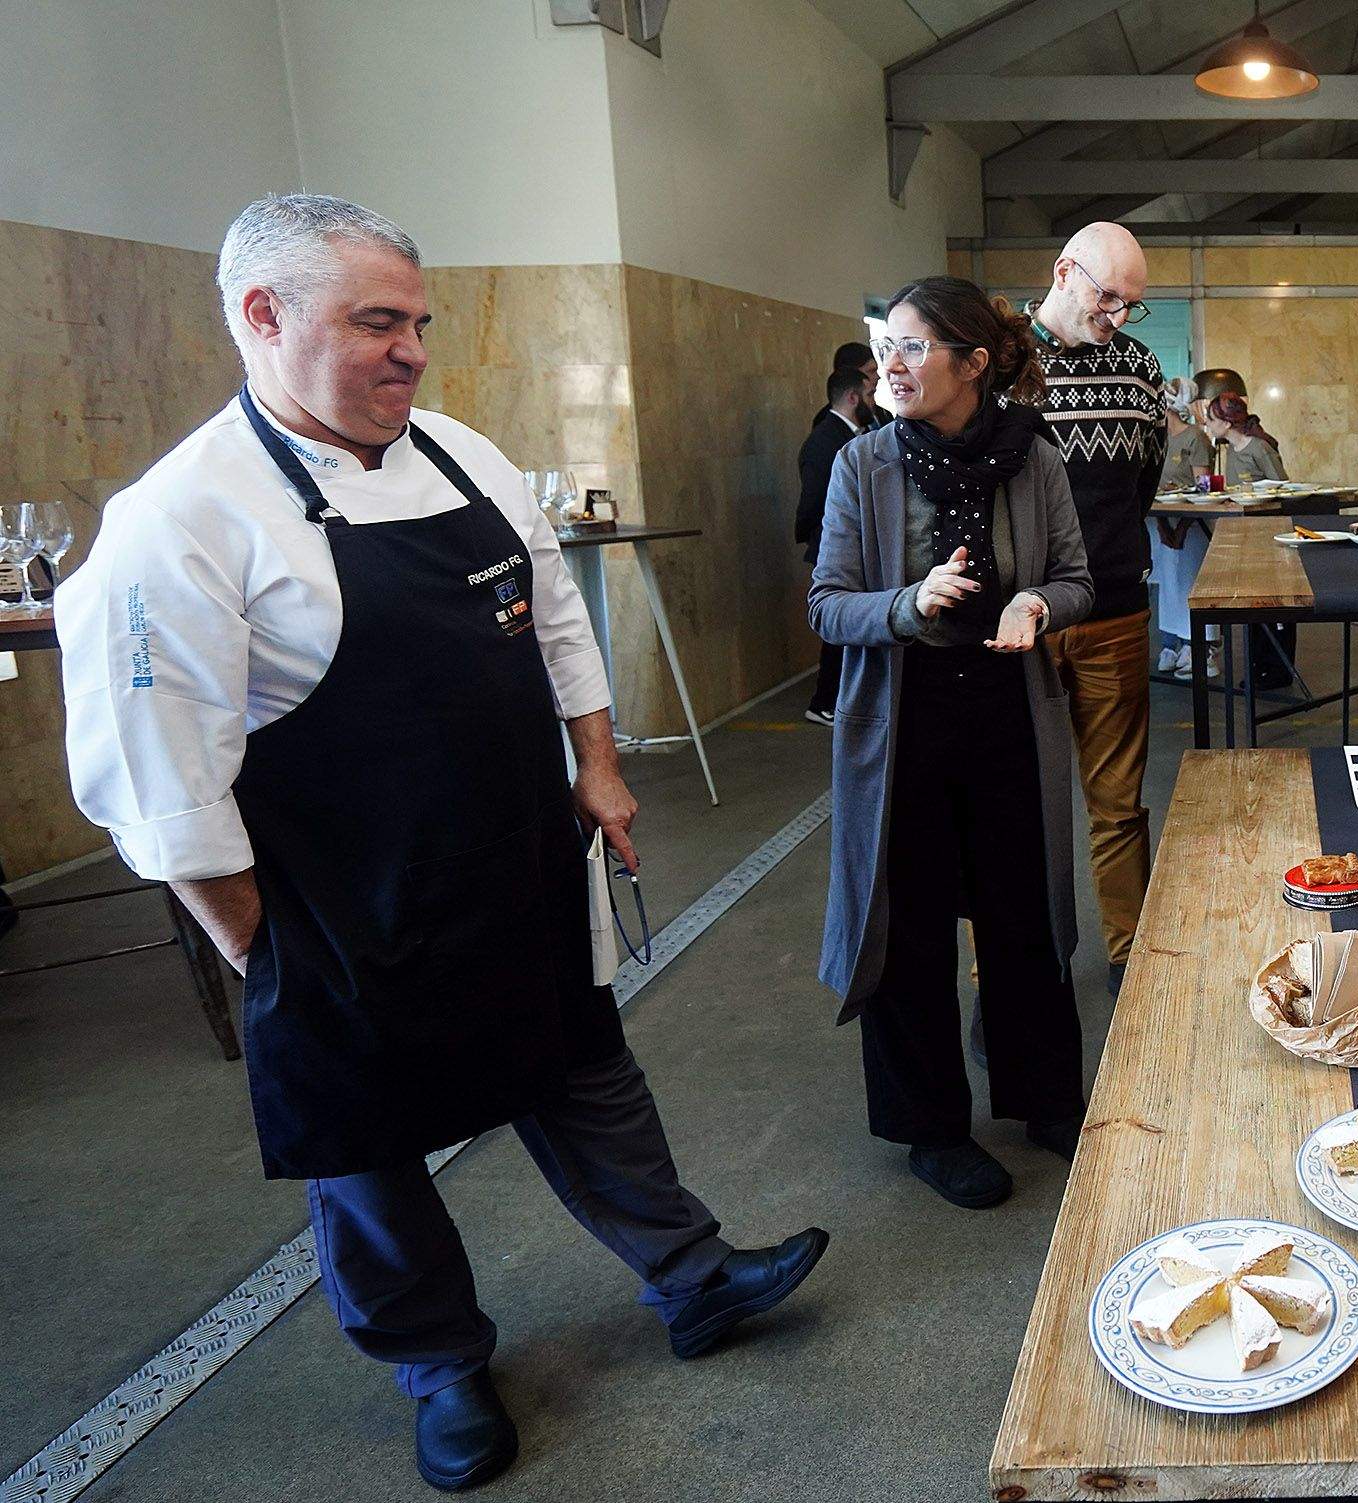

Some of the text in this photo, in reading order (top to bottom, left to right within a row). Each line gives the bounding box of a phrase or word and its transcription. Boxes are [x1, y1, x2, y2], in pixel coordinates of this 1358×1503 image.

[284, 435, 338, 468] Ricardo FG
[467, 561, 510, 586] RICARDO
[132, 651, 141, 676] XUNTA
[140, 637, 152, 676] DE GALICIA
